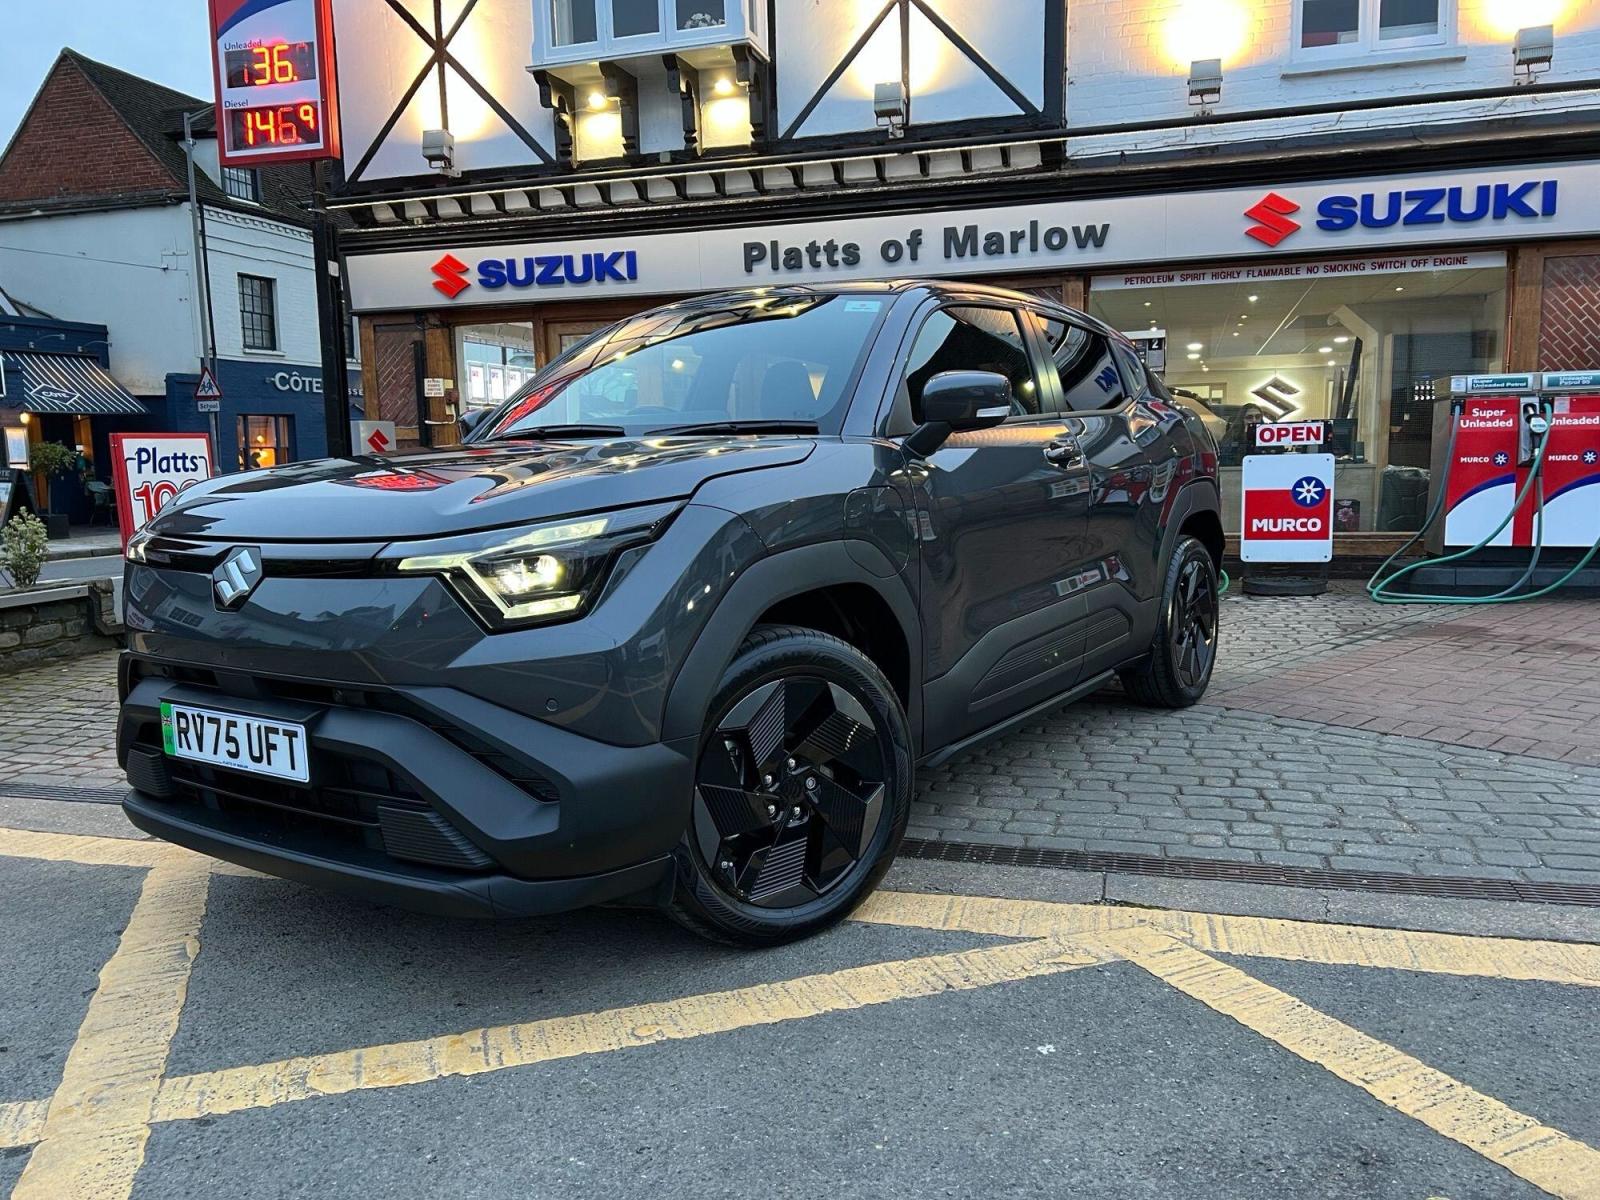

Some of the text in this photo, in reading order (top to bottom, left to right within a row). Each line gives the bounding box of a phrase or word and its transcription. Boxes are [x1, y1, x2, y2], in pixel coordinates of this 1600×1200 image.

[224, 40, 262, 50] Unleaded
[224, 99, 249, 108] Diesel
[1315, 180, 1558, 231] SUZUKI
[743, 219, 1111, 273] Platts of Marlow
[477, 250, 639, 289] SUZUKI
[1124, 255, 1469, 286] PETROLEUM SPIRIT HIGHLY FLAMMABLE NO SMOKING SWITCH OFF ENGINE
[1151, 338, 1159, 349] 2
[274, 370, 324, 393] CÔTE
[1459, 418, 1514, 429] Unleaded
[1471, 408, 1506, 419] Super
[1259, 425, 1322, 443] OPEN
[135, 446, 199, 474] Platts
[1460, 456, 1490, 464] MURCO
[133, 479, 200, 522] 10
[1252, 518, 1322, 533] MURCO
[175, 710, 299, 771] RV75 UFT
